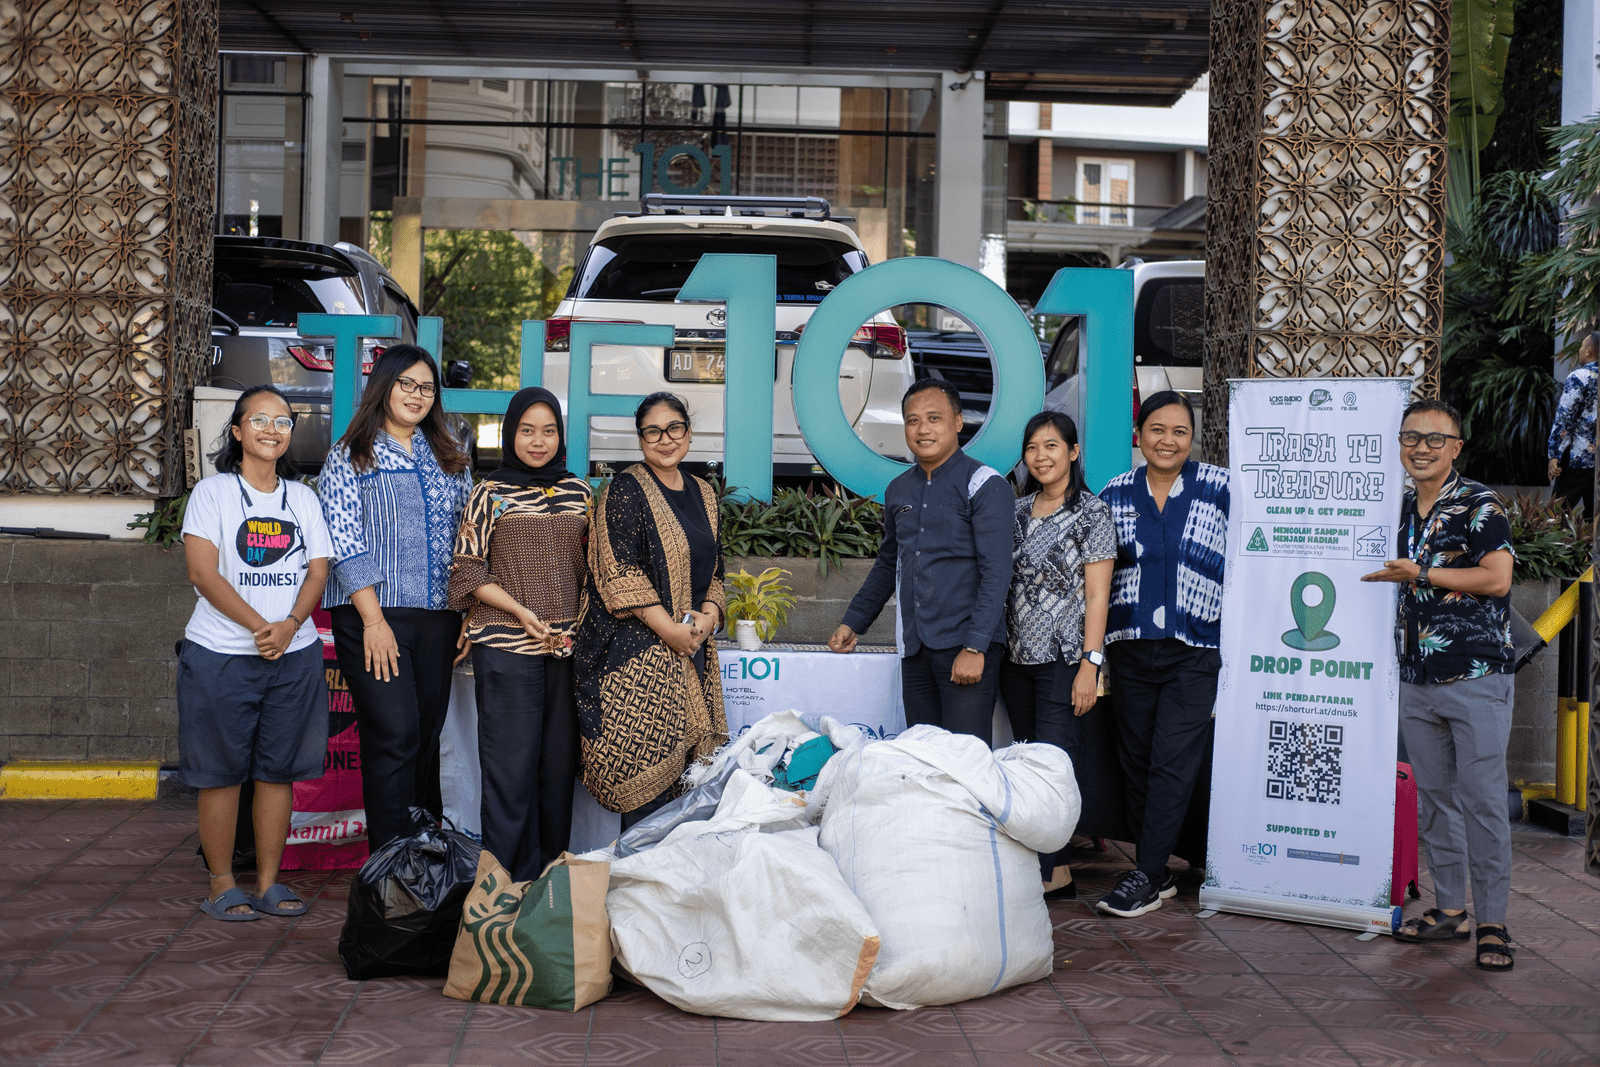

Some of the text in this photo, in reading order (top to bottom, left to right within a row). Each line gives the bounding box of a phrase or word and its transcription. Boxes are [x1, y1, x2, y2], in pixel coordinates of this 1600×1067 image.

[552, 143, 732, 196] THE 101
[673, 354, 692, 371] AD
[676, 253, 1135, 504] 101
[1245, 427, 1382, 464] TRASH TO
[1241, 464, 1385, 501] TREASURE
[1266, 506, 1365, 517] CLEAN UP & GET PRIZE!
[247, 520, 281, 535] WORLD
[1314, 528, 1349, 536] SAMPAH
[247, 533, 290, 549] CLEANUP
[1272, 535, 1339, 544] MENJADI HADIAH
[247, 547, 266, 562] DAY
[239, 572, 298, 587] INDONESI
[720, 656, 780, 681] HE 101
[1250, 655, 1373, 680] DROP POINT
[1263, 691, 1353, 706] LINK PENDAFTARAN
[1255, 702, 1358, 718] https://shorturl.at/dnu5k
[1266, 823, 1337, 839] SUPPORTED BY
[1241, 842, 1277, 856] THE 101
